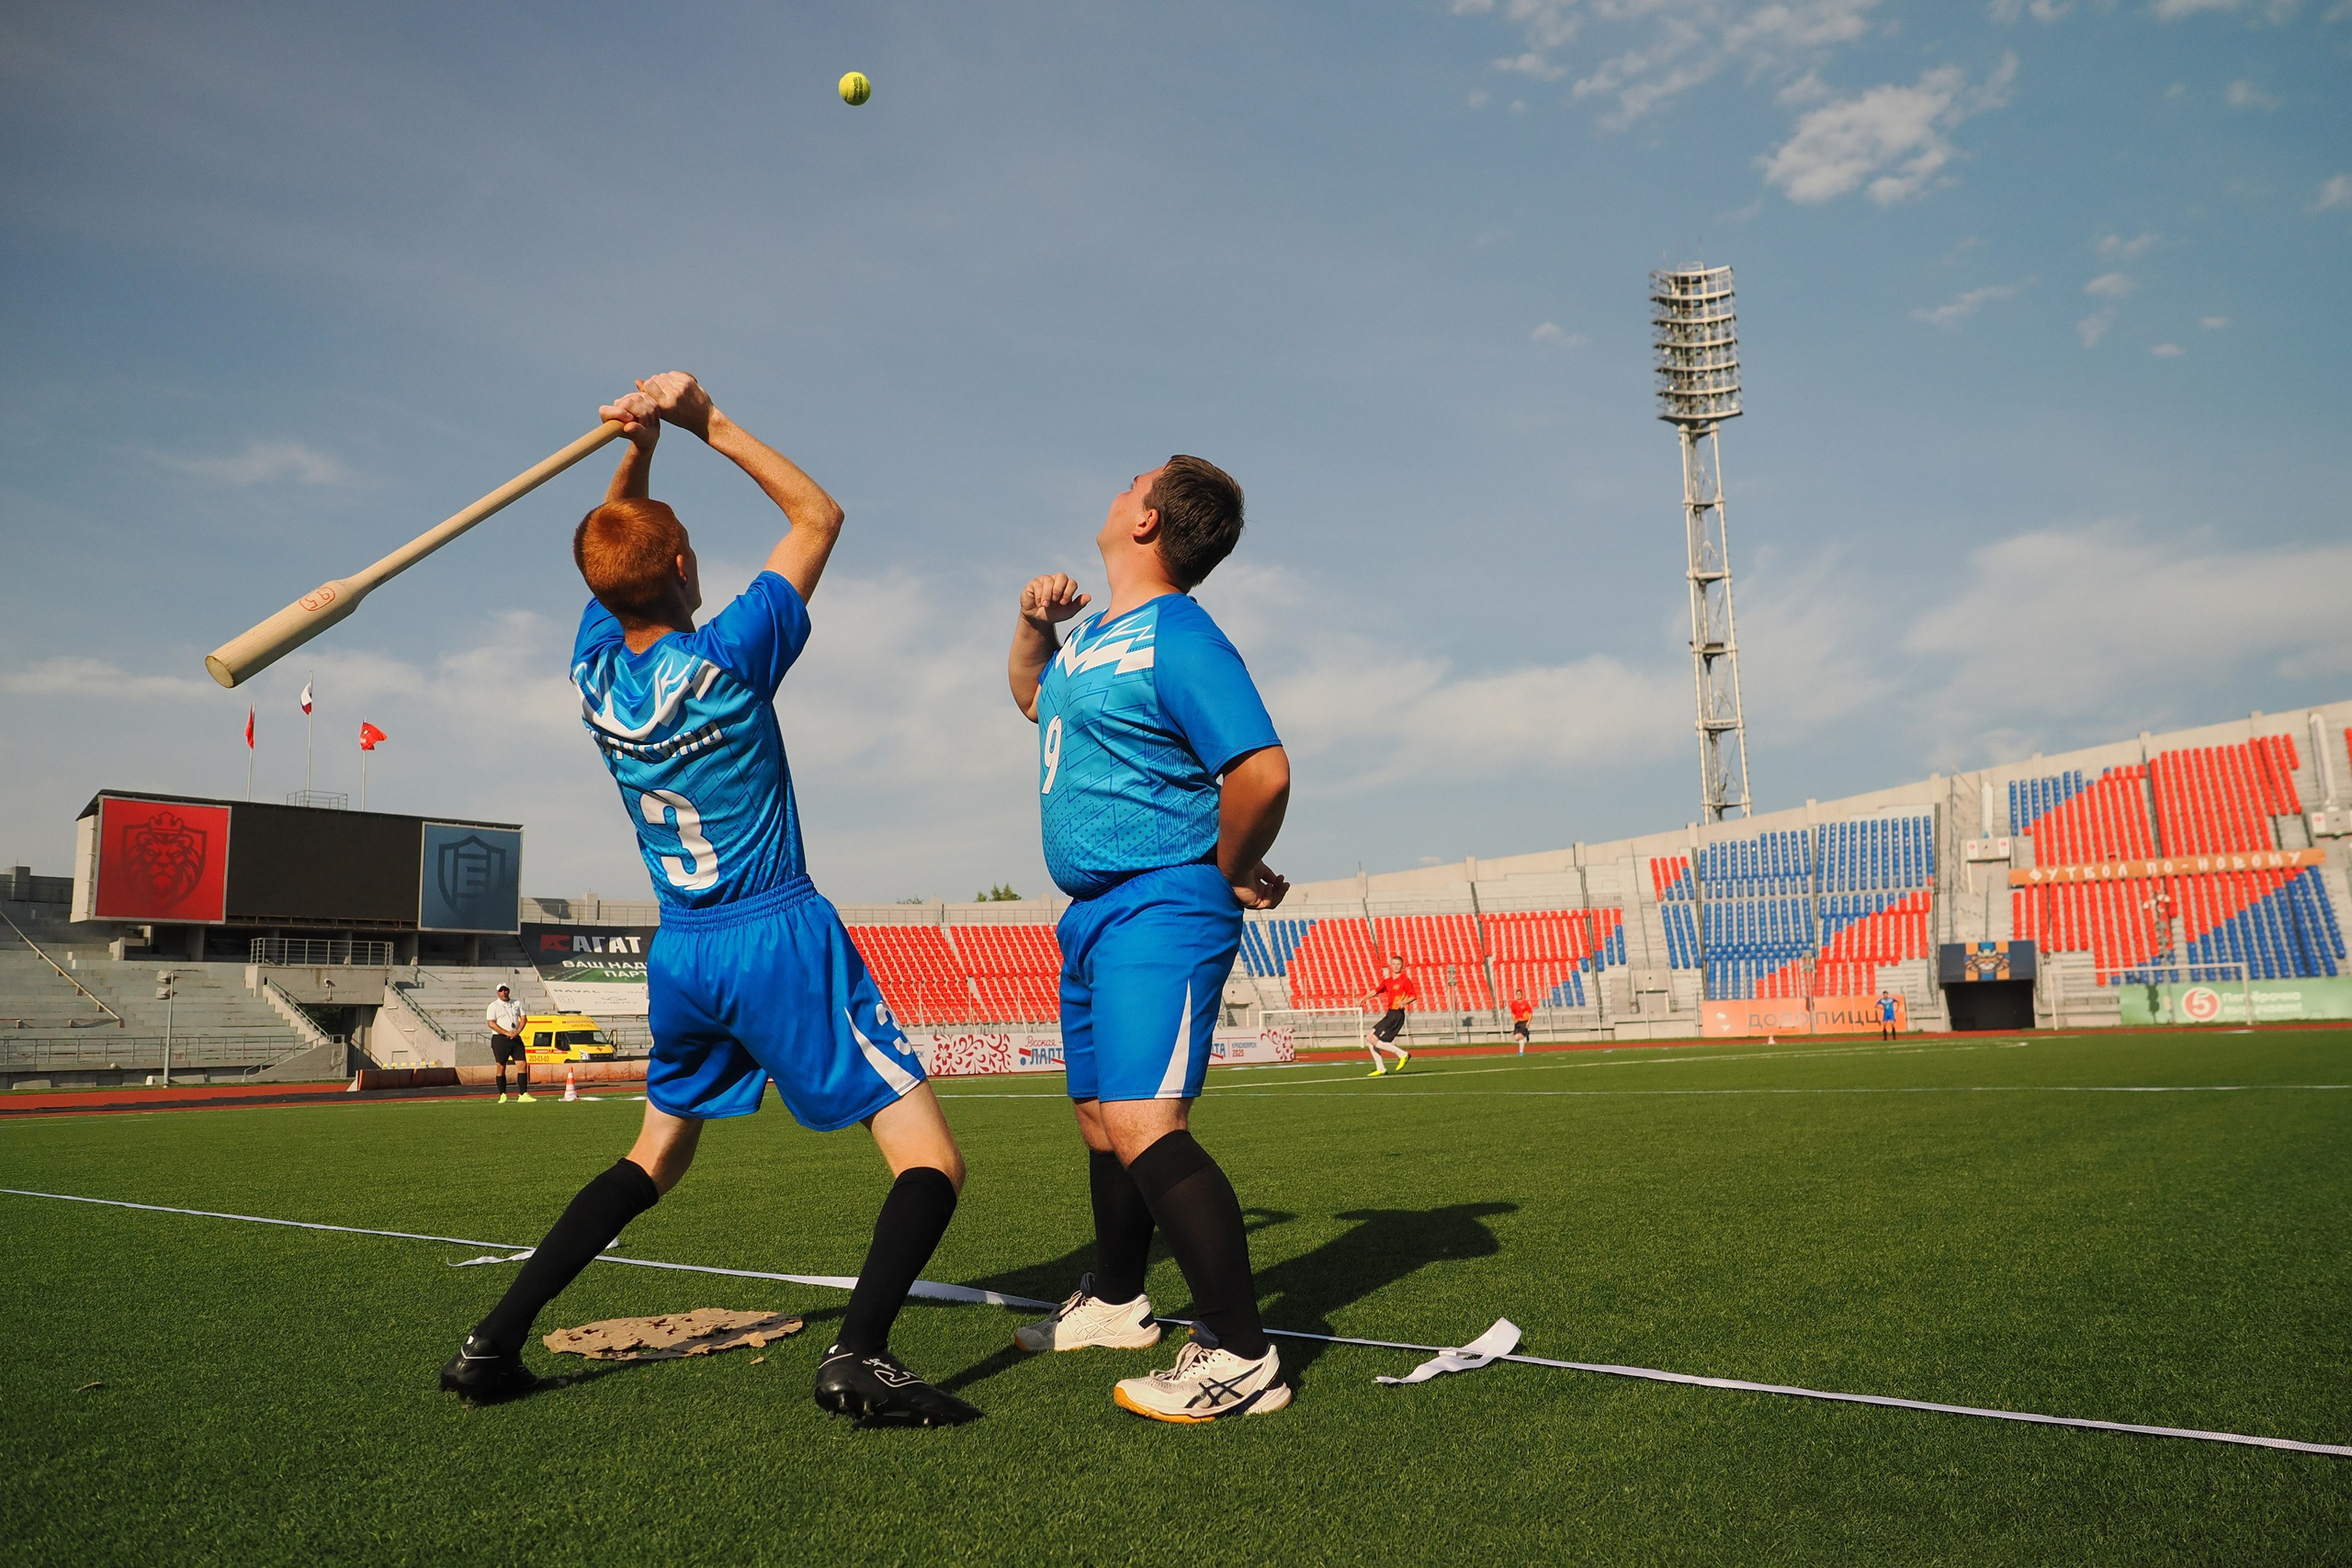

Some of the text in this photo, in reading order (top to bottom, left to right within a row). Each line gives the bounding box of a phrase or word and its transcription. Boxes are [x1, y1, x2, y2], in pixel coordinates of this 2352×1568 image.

[1041, 714, 1063, 795] 9
[639, 789, 719, 890] 3
[2029, 852, 2301, 882] ФУТБОЛ ПО-НОВОМУ
[572, 935, 641, 953] АГАТ
[561, 960, 648, 970] ВАШ НАД
[1815, 1010, 1882, 1026] ПИЦЦ
[876, 1000, 911, 1055] 3
[1030, 1048, 1064, 1065] ЛАПТ
[1232, 1049, 1244, 1057] 2025
